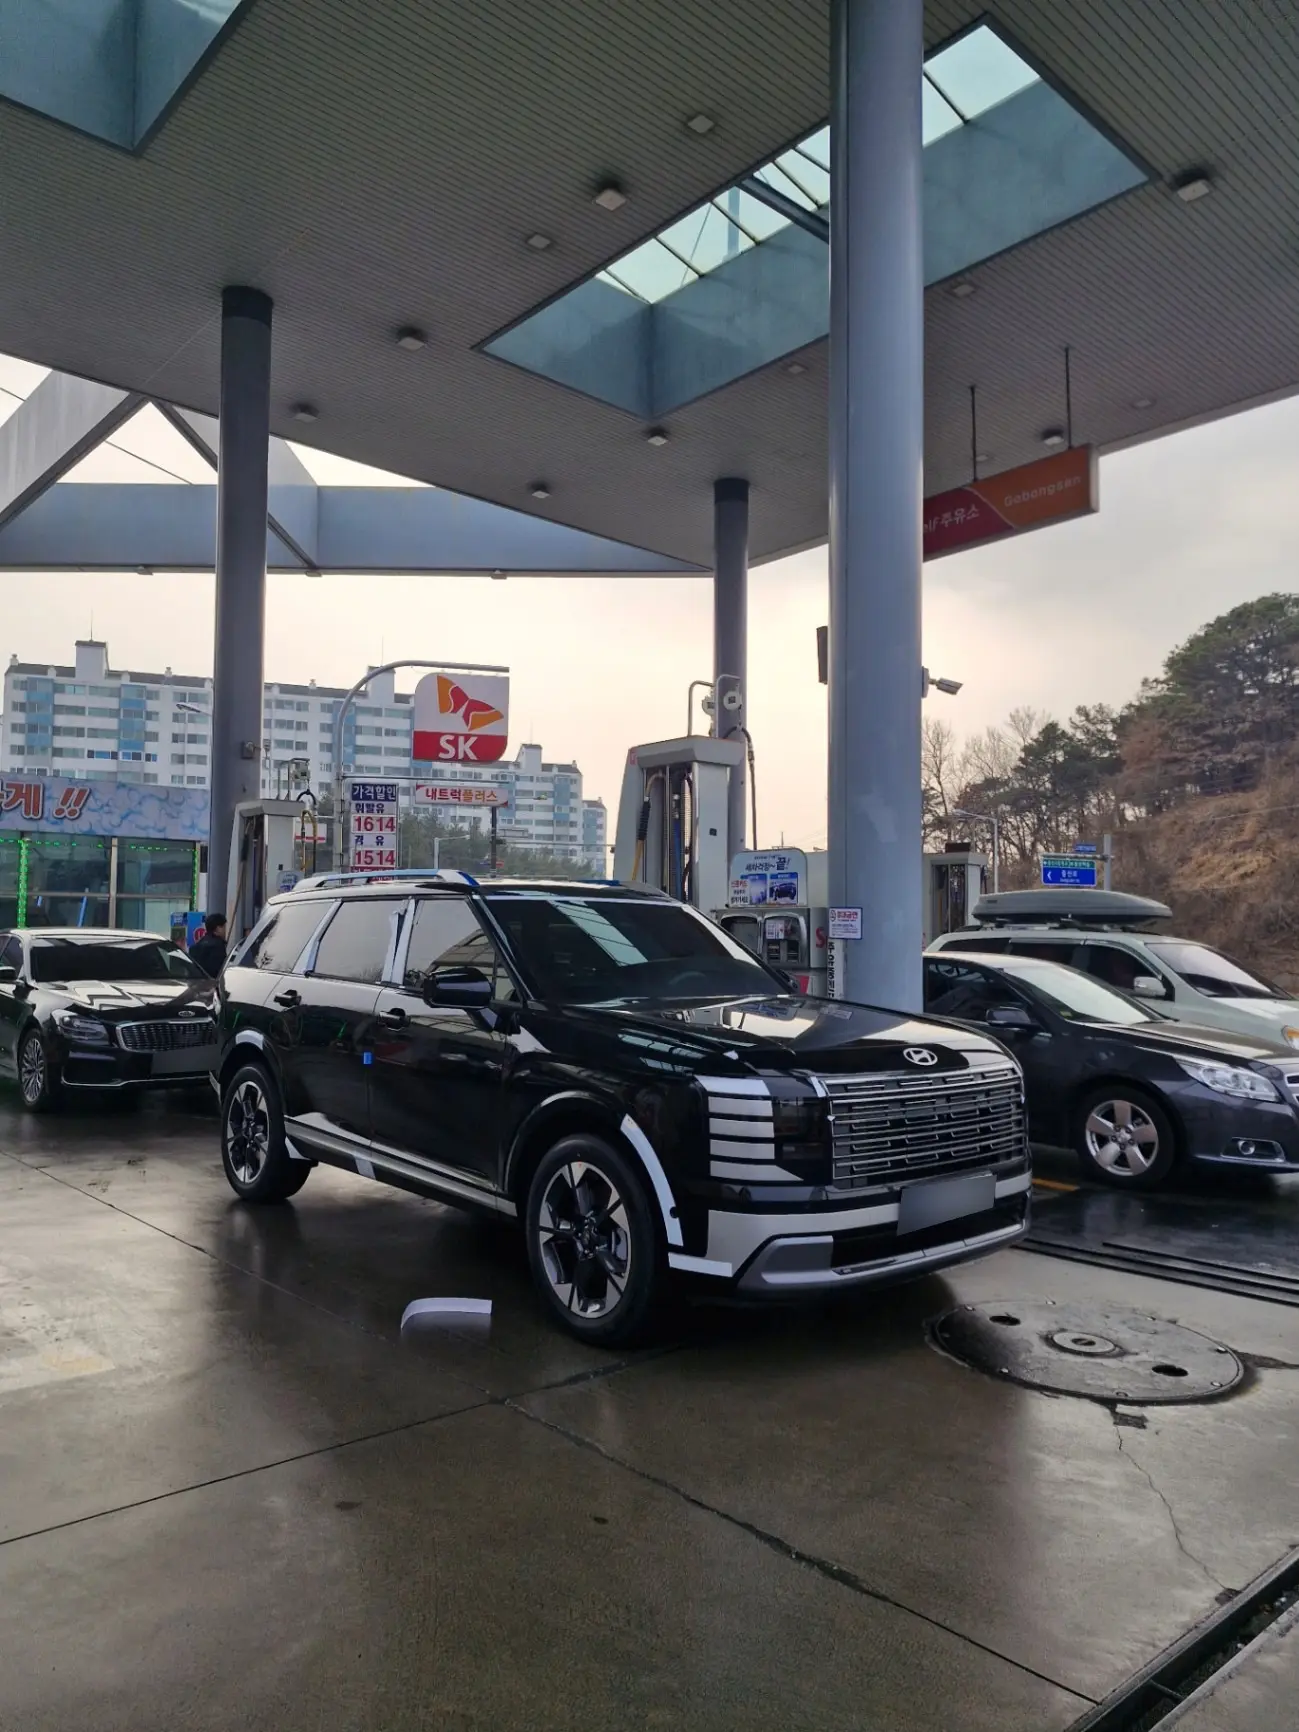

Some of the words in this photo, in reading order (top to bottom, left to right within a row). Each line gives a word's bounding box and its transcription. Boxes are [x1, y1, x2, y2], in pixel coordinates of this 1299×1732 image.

[923, 503, 980, 535] elf주유소
[438, 734, 478, 760] SK
[0, 780, 43, 819] 게
[353, 785, 396, 800] 가격할인
[425, 787, 498, 803] 내트럭플러스
[354, 816, 396, 832] 1614
[354, 850, 396, 866] 1514
